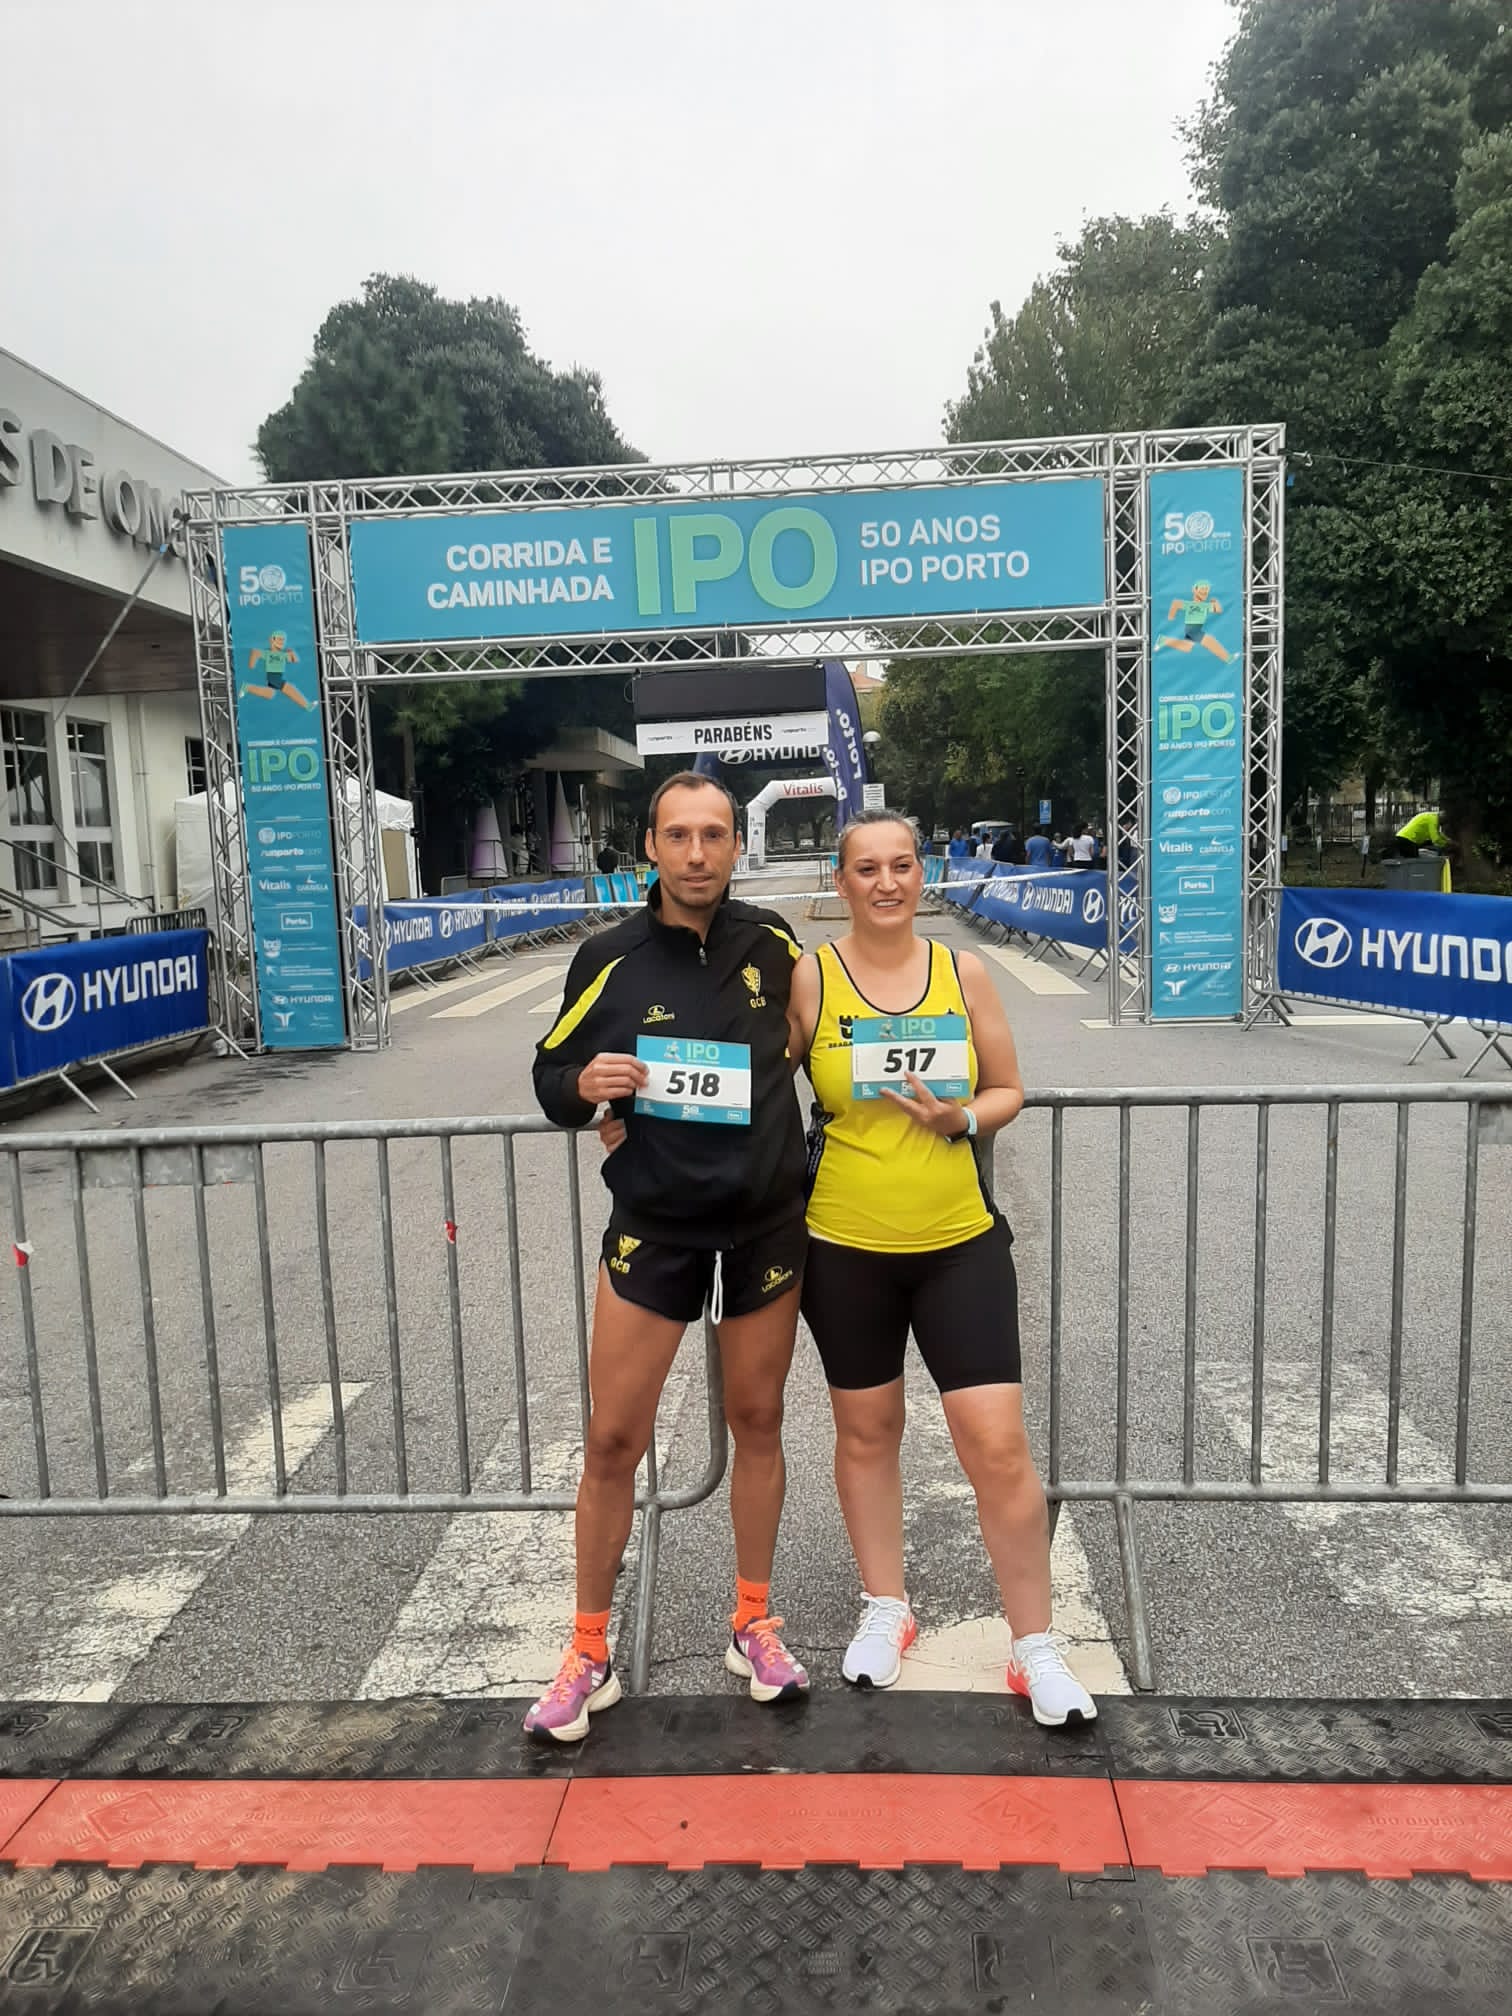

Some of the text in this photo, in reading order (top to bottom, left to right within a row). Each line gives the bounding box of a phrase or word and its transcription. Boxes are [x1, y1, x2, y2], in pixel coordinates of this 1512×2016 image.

[29, 429, 98, 520] DE
[860, 515, 1001, 549] 50 ANOS
[446, 537, 613, 572] CORRIDA E
[633, 506, 838, 616] IPO
[860, 551, 1030, 586] IPO PORTO
[427, 575, 615, 608] CAMINHADA
[694, 722, 773, 744] PARABÉNS
[1159, 701, 1235, 740] IPO
[248, 747, 319, 784] IPO
[783, 783, 823, 796] Vitalis
[1160, 841, 1193, 853] Vitalis
[259, 878, 292, 891] Vitalis
[1034, 884, 1074, 915] HYUNDAI
[392, 916, 433, 945] HYUNDAI
[1183, 961, 1233, 972] HYUNDAI
[82, 955, 198, 1013] HYUNDAI
[290, 994, 335, 1004] HYUNDAI
[902, 1018, 937, 1035] IPO
[686, 1041, 720, 1060] IPO
[883, 1048, 937, 1074] 517
[666, 1070, 720, 1097] 518
